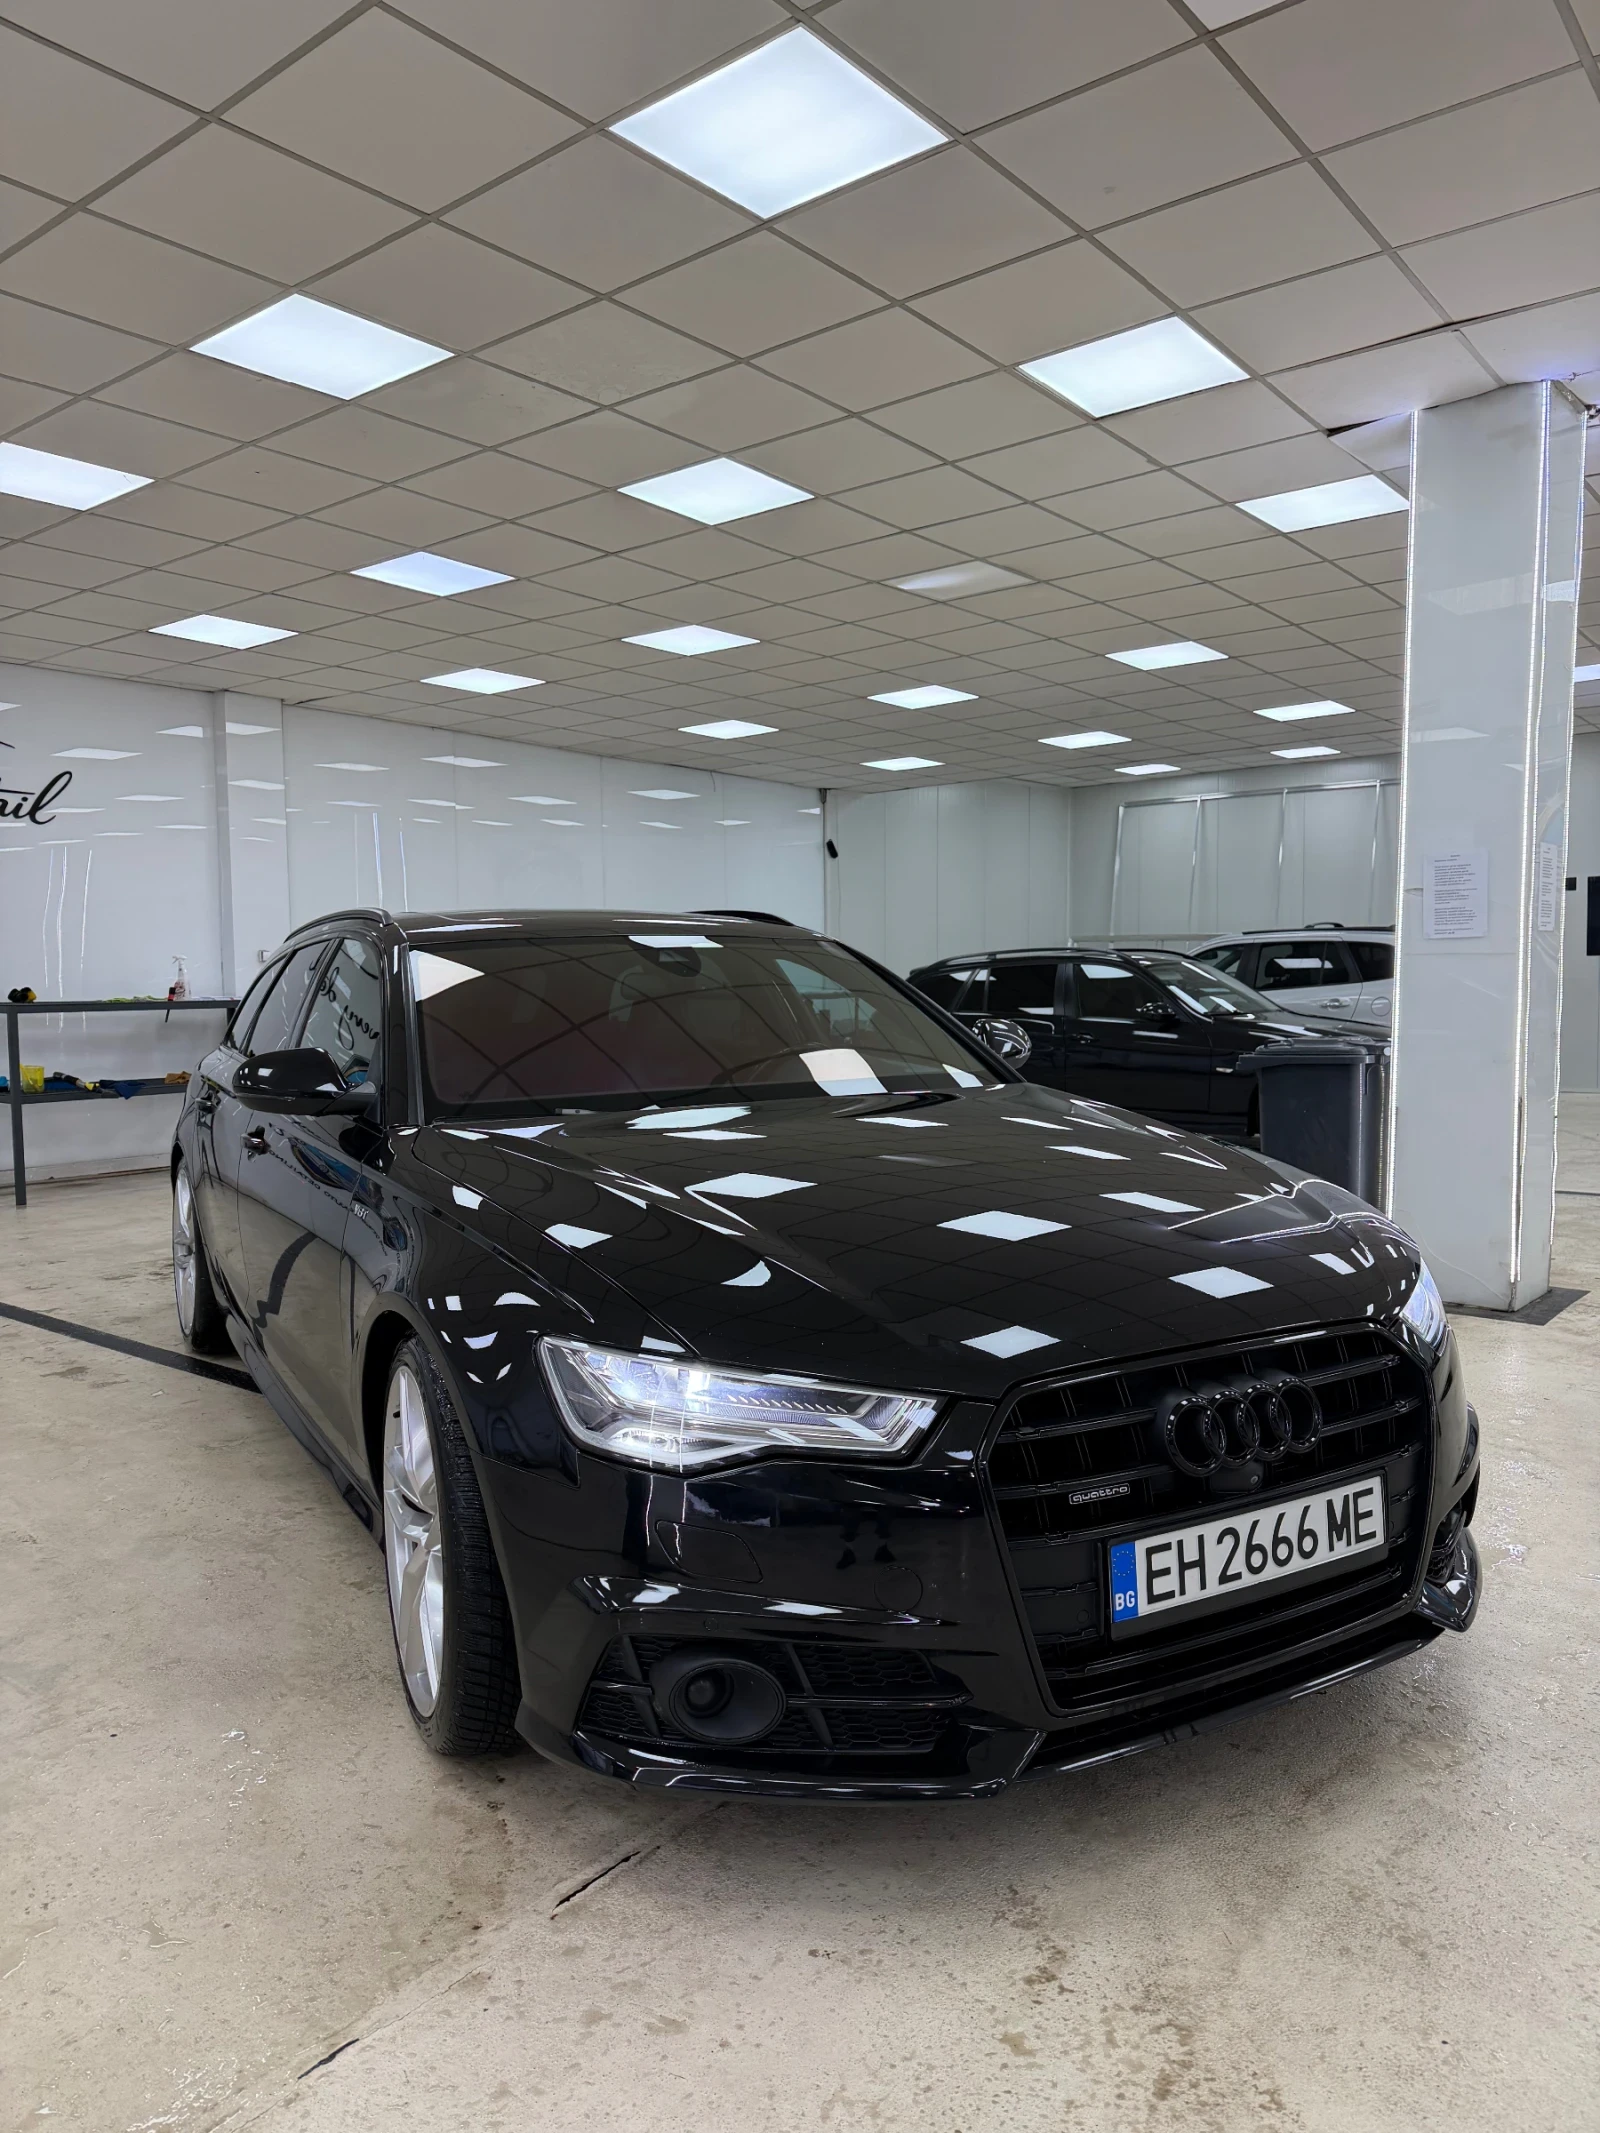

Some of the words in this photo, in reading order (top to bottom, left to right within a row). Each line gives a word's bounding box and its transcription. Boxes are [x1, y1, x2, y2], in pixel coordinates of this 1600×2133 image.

[0, 771, 72, 825] ail
[1072, 1486, 1128, 1502] quattro
[1114, 1590, 1136, 1612] BG
